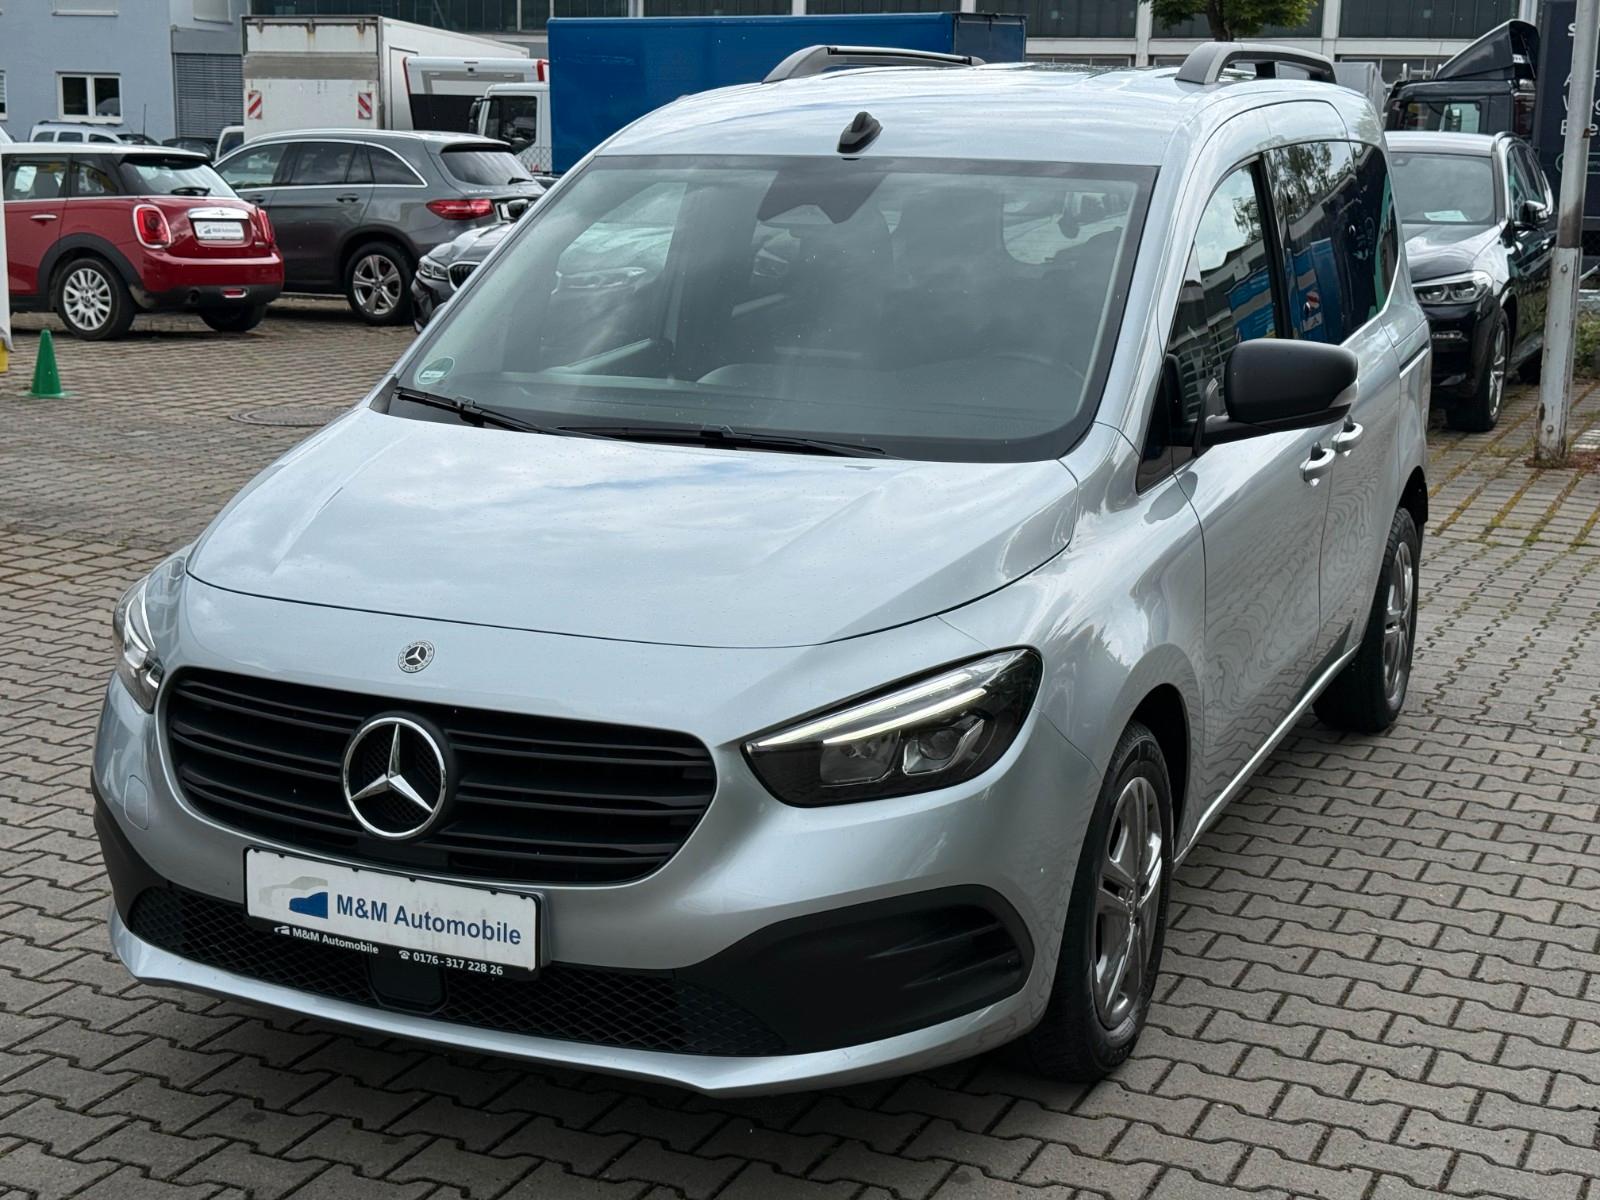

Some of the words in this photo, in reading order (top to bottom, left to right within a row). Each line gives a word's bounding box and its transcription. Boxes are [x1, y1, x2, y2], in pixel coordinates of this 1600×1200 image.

[336, 894, 388, 923] M&M
[394, 905, 522, 945] Automobile
[293, 927, 320, 942] M&M
[322, 933, 379, 955] Automobile
[467, 960, 487, 973] 228
[489, 964, 503, 976] 26
